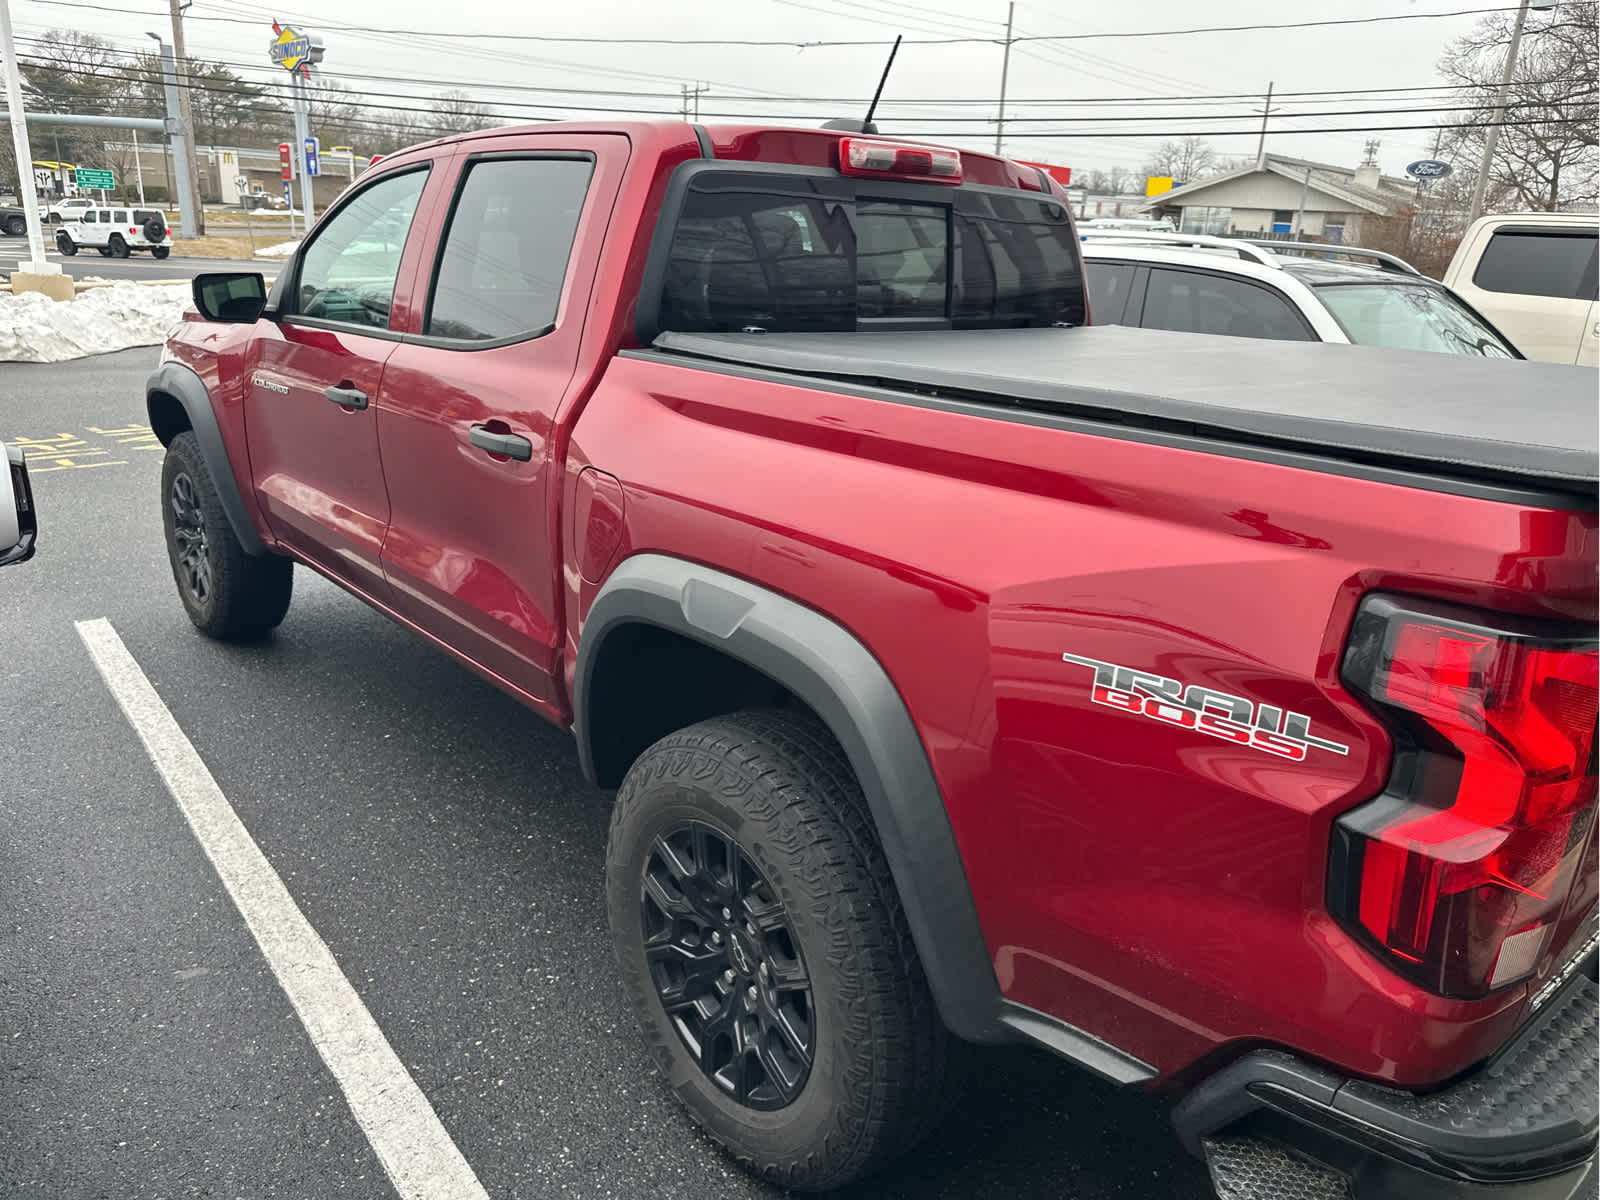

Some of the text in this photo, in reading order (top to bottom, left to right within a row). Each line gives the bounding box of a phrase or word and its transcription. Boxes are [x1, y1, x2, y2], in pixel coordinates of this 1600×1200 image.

[272, 39, 306, 59] SUNOCO
[1414, 162, 1443, 175] Ford
[1062, 652, 1349, 756] TRAIL
[1091, 685, 1308, 762] BOSS
